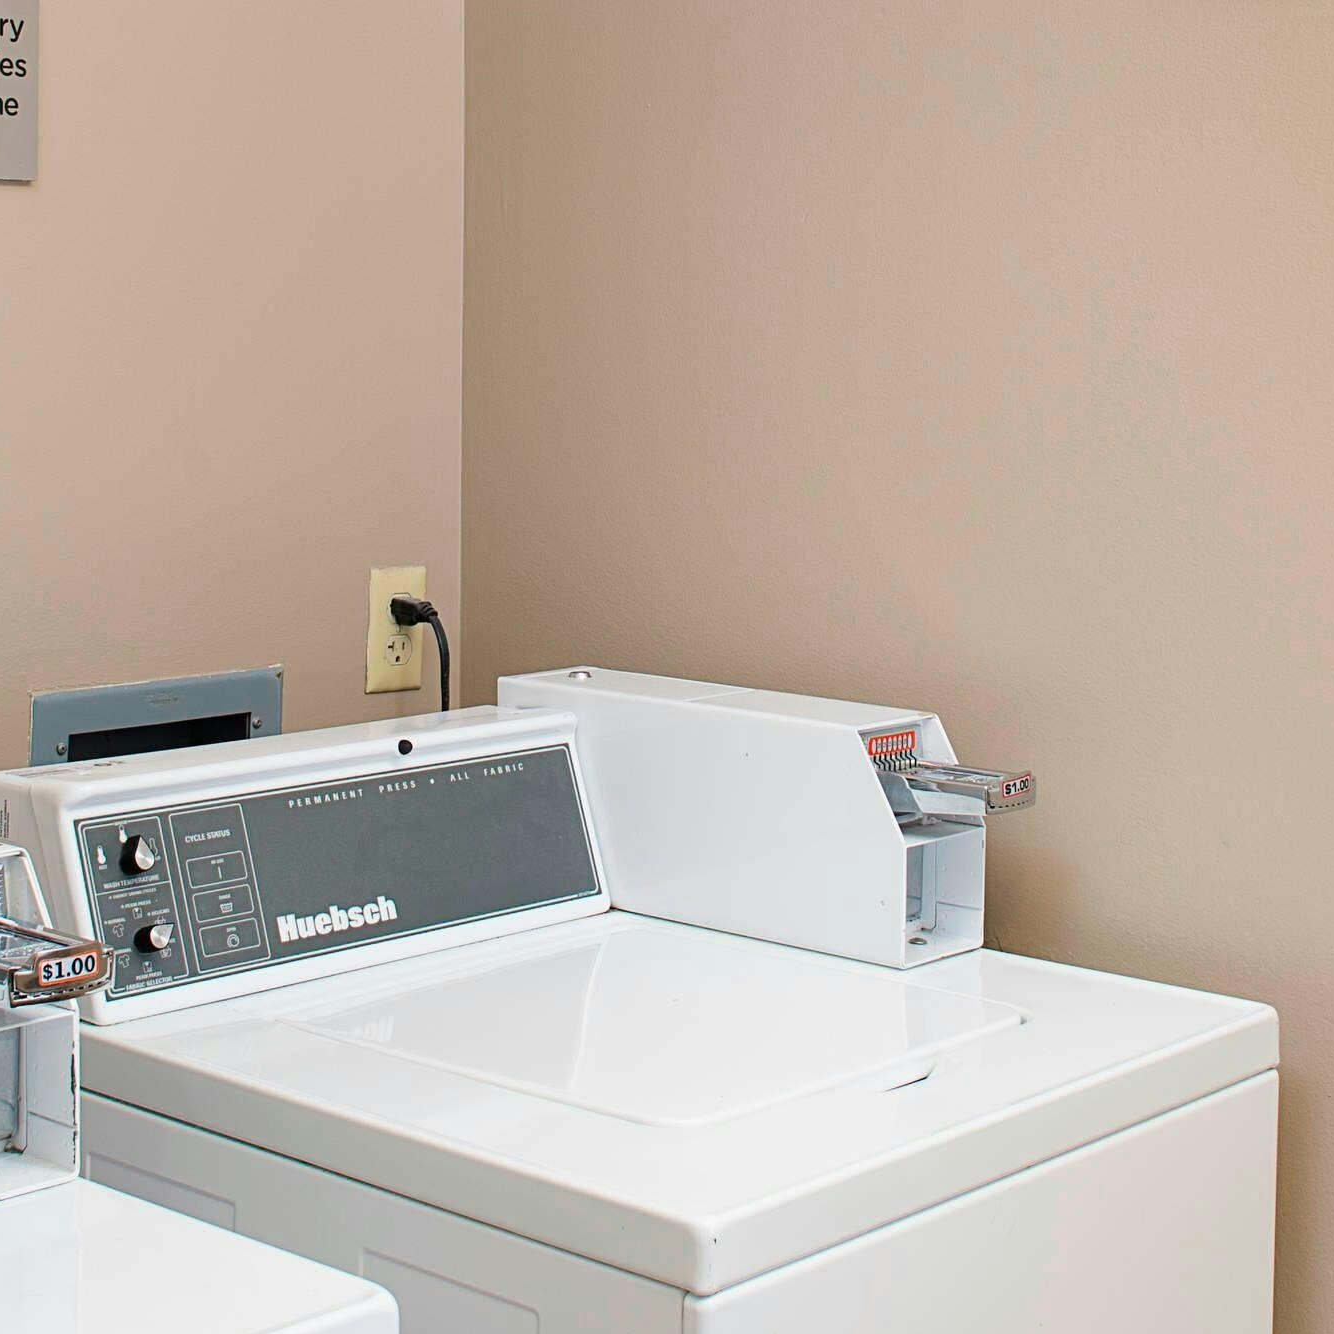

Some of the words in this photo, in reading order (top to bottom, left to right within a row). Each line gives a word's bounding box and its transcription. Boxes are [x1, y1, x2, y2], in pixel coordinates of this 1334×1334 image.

[288, 788, 364, 809] PERMANENT
[379, 780, 417, 793] PRESS
[450, 771, 470, 783] ALL
[483, 763, 524, 777] FABRIC
[1004, 778, 1030, 796] $1.00
[185, 834, 206, 843] CYCLE
[206, 829, 231, 841] STATUS
[277, 896, 397, 943] Huebsch
[43, 955, 96, 981] $1.00
